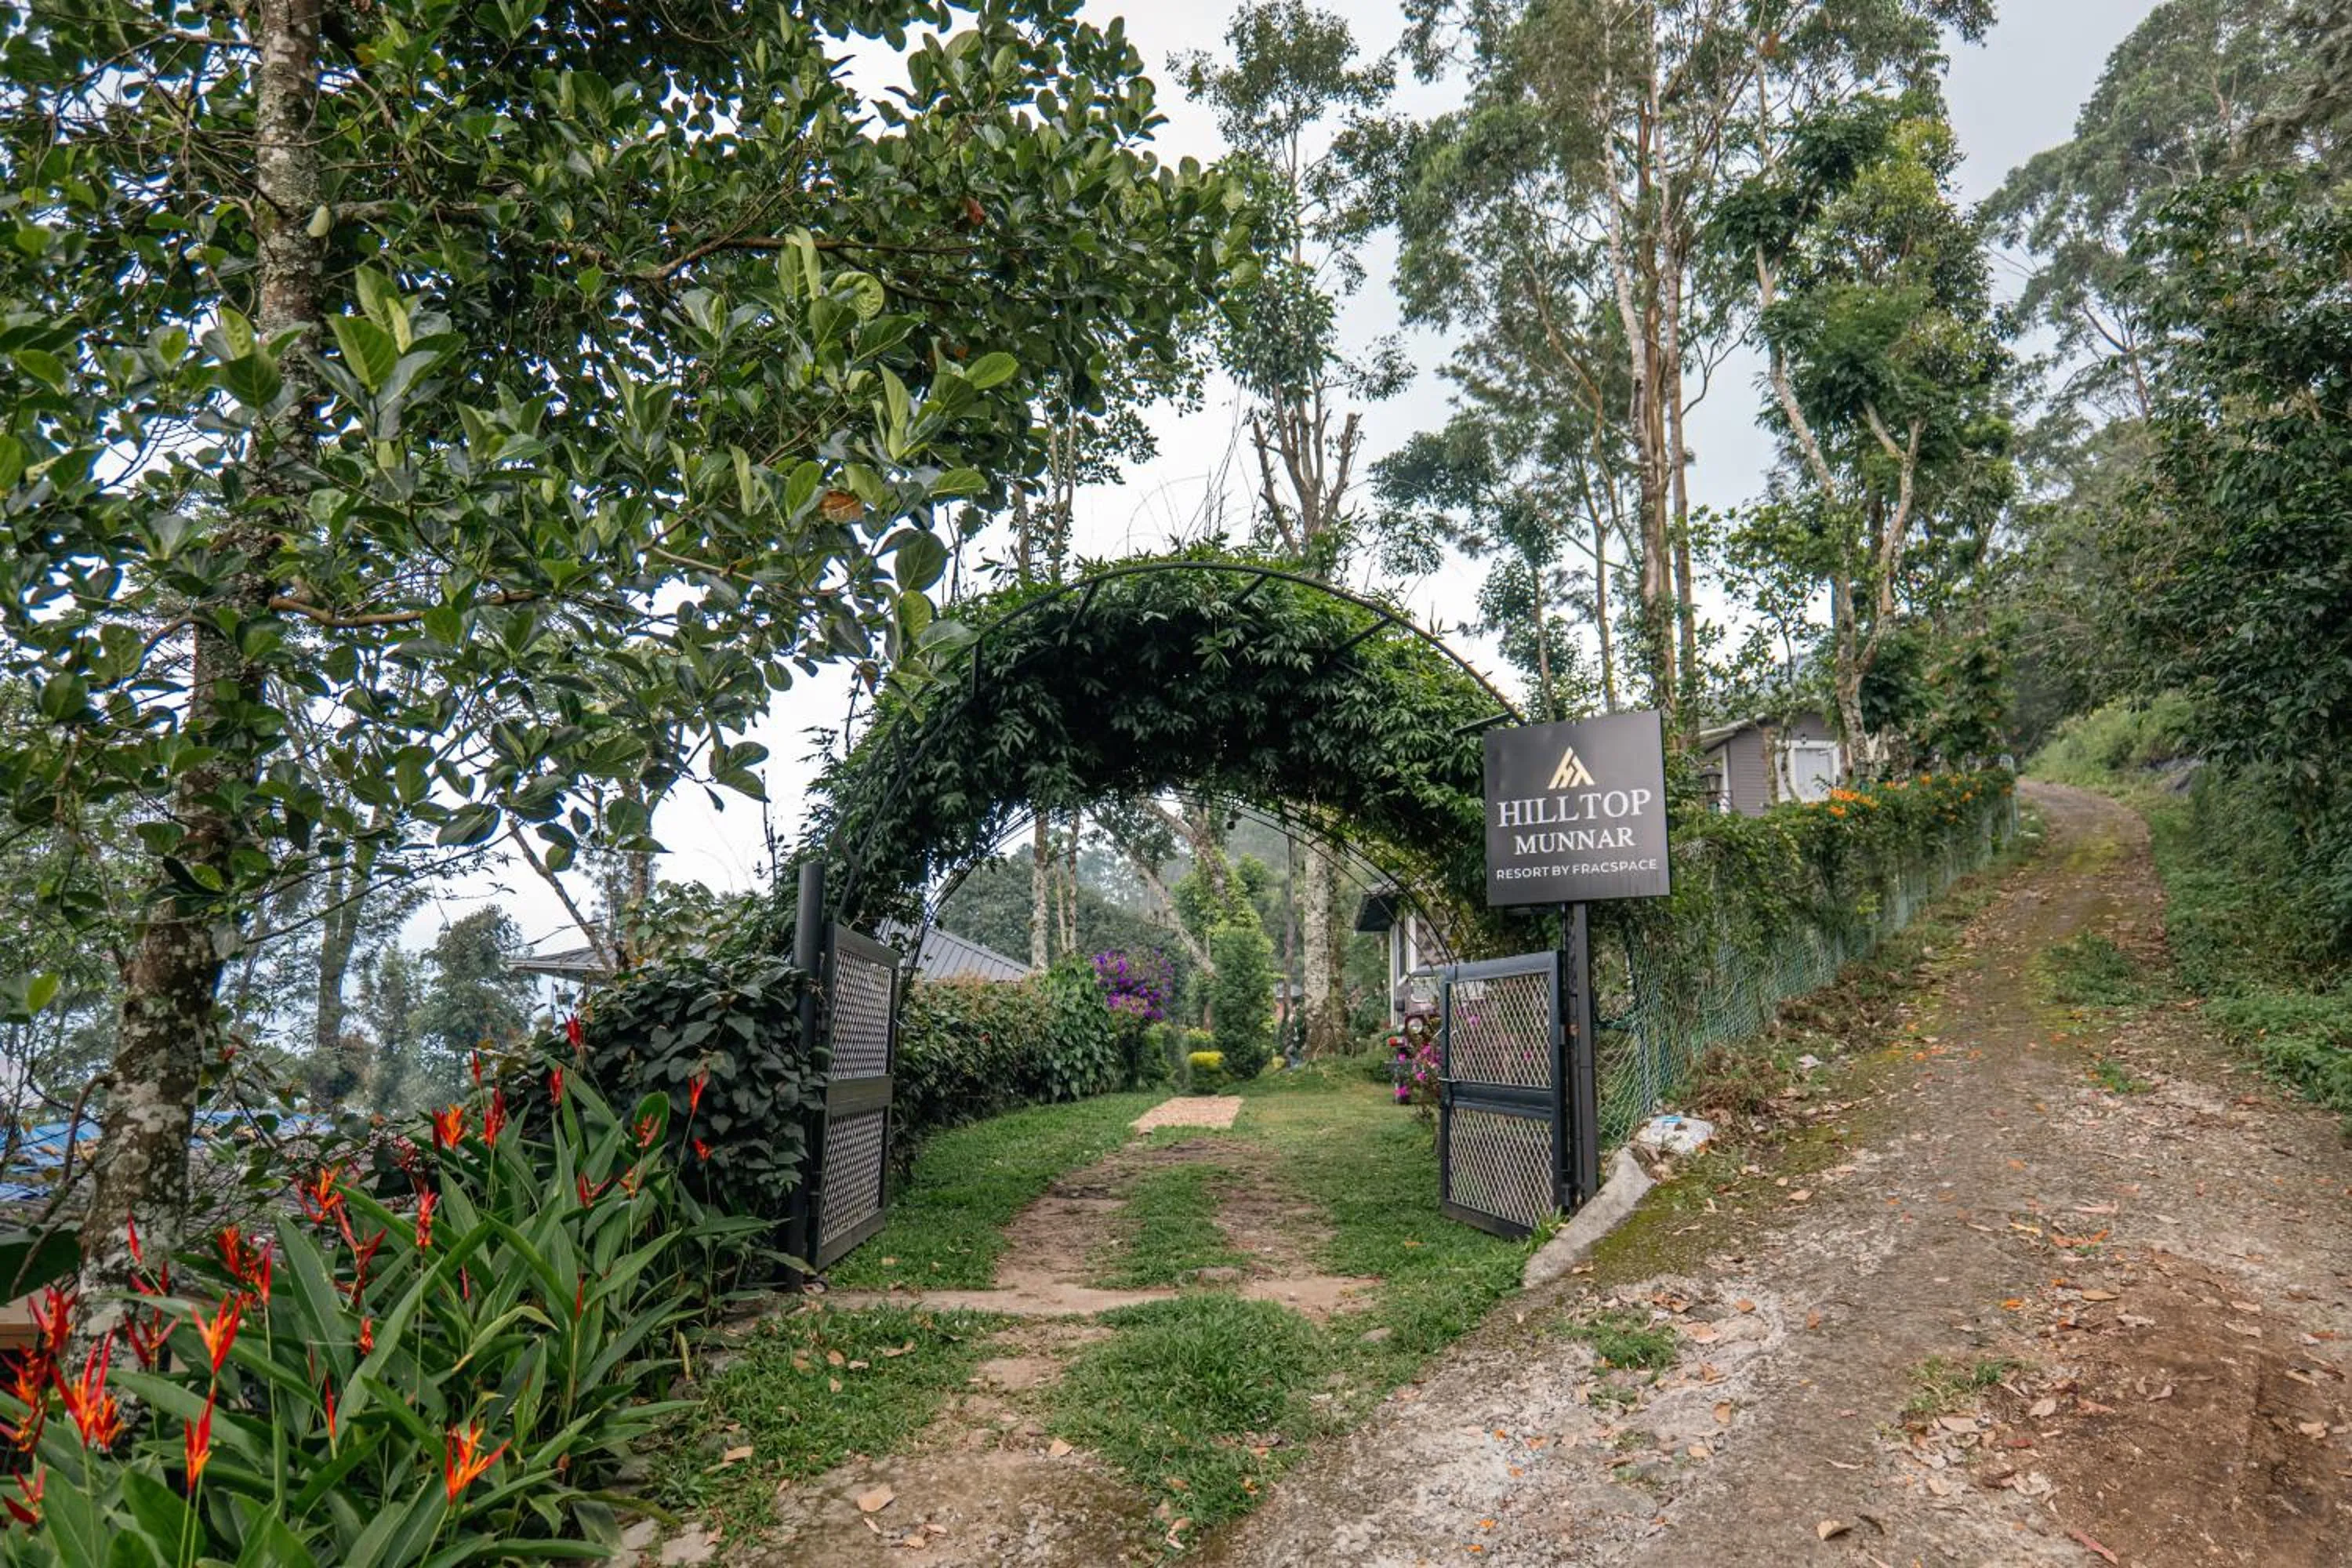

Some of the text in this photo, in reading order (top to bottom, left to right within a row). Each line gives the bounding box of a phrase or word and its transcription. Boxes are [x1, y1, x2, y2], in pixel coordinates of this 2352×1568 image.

[1497, 789, 1652, 827] HILLTOP
[1514, 827, 1637, 855] MUNNAR
[1496, 858, 1657, 880] RESORT BY FRACSPACE
